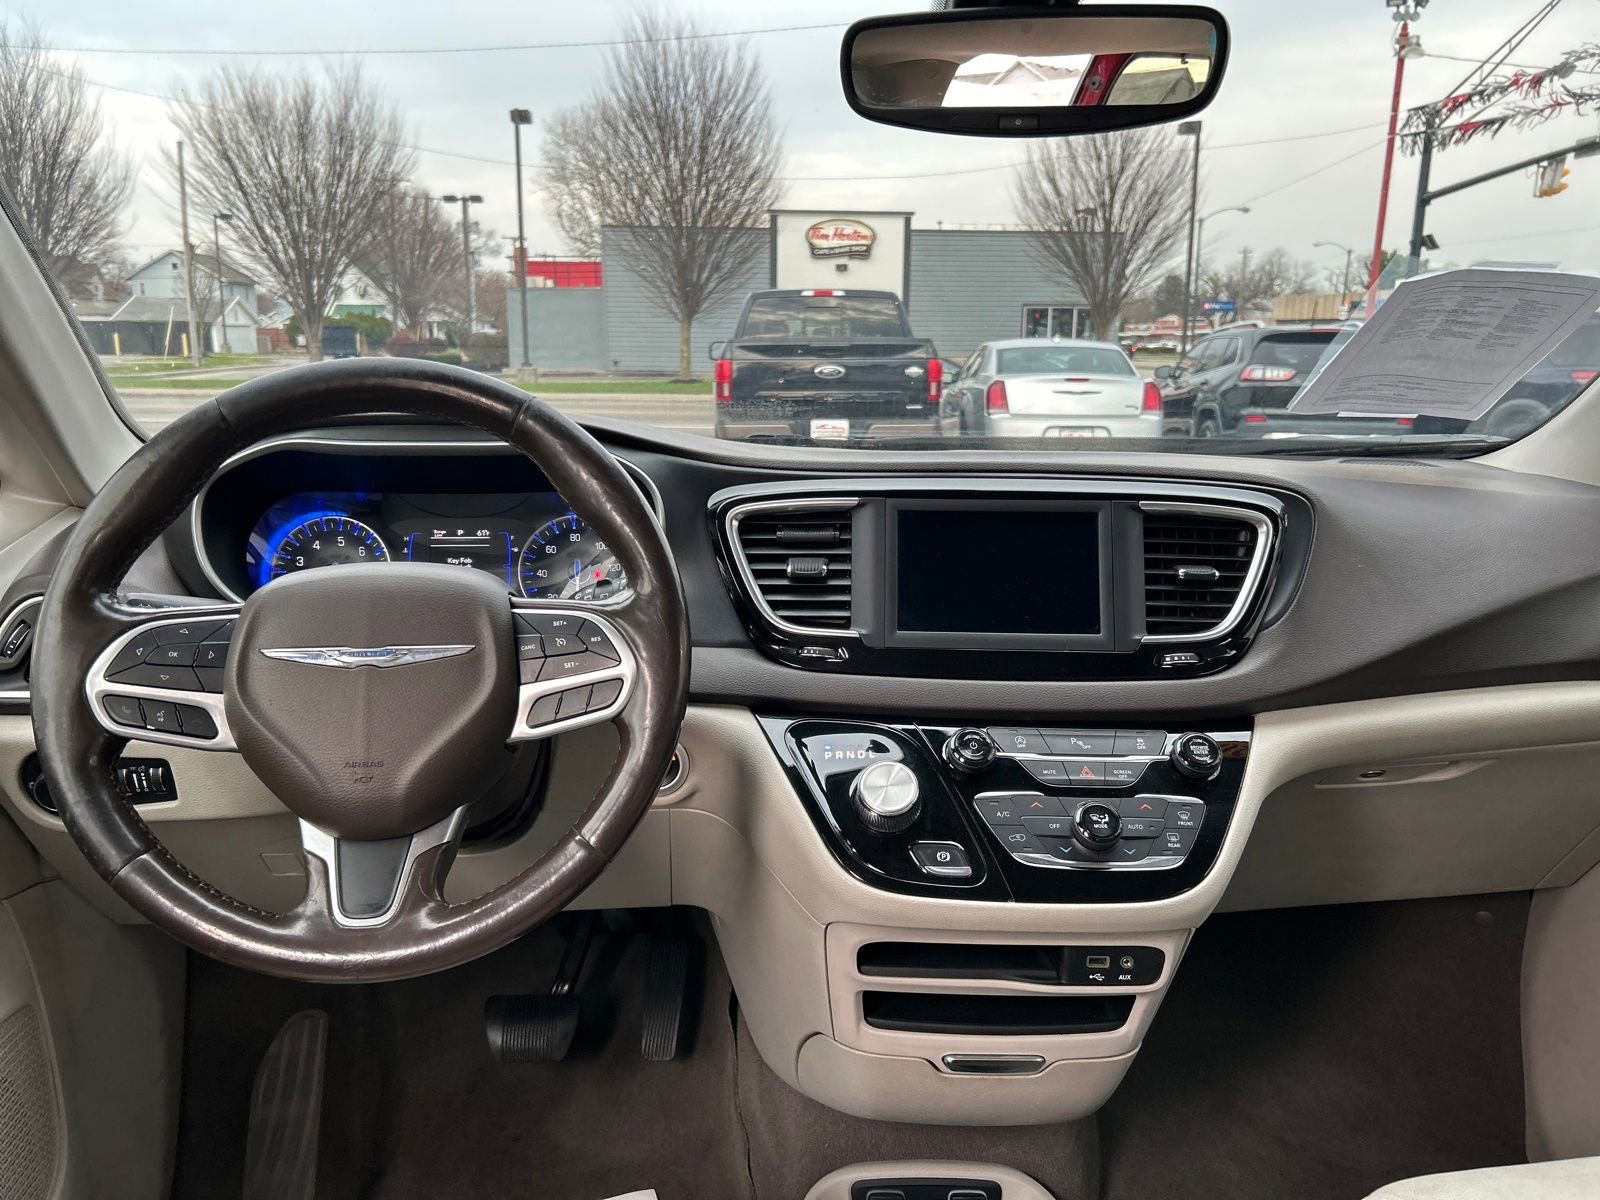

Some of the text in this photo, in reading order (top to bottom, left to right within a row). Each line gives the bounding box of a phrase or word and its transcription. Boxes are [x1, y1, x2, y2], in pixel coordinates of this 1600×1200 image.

[337, 536, 345, 547] 5
[569, 533, 581, 542] 80
[312, 540, 321, 551] 4
[545, 545, 557, 554] 60
[358, 546, 366, 557] 6
[296, 556, 304, 567] 3
[447, 557, 460, 565] Key
[536, 569, 548, 578] 40
[520, 643, 536, 651] CANC
[1127, 823, 1144, 831] AUTO
